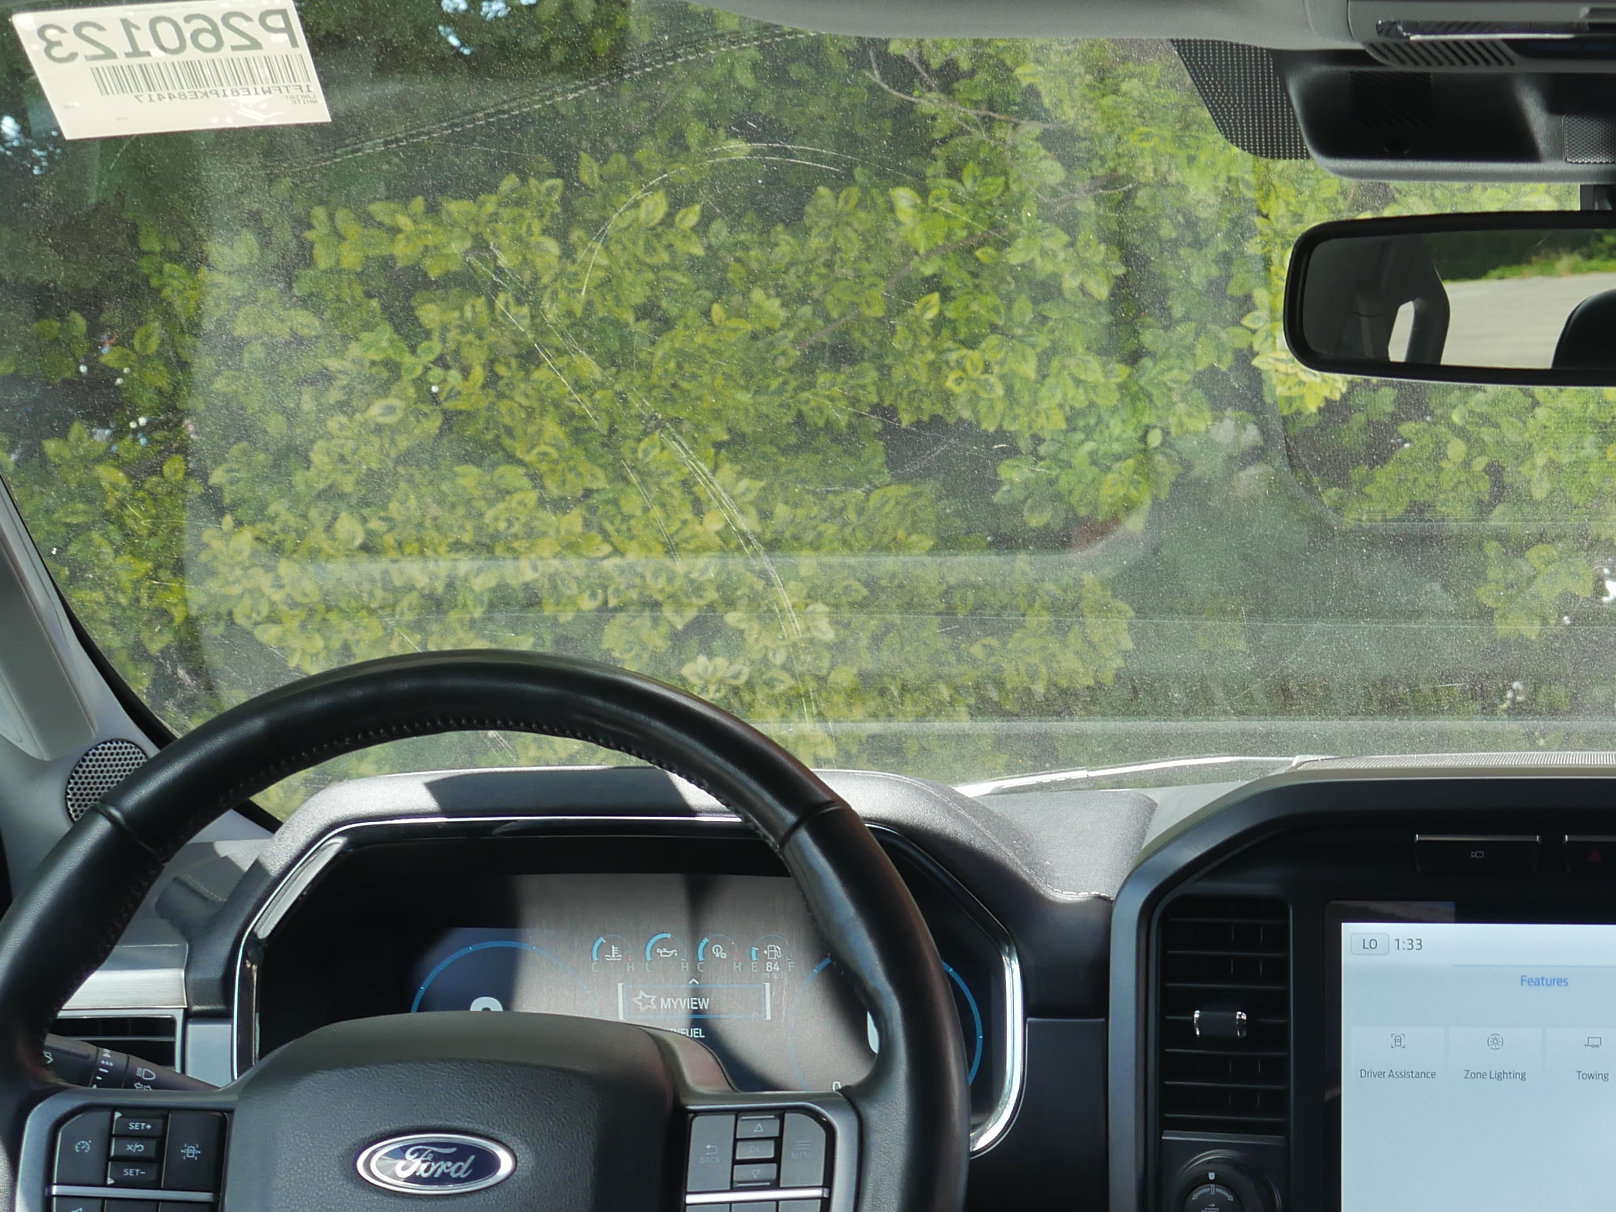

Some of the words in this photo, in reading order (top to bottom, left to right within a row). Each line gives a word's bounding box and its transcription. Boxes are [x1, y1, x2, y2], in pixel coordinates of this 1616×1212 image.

[1362, 938, 1378, 950] LO
[1395, 938, 1423, 951] 1:33
[765, 961, 780, 972] 84
[1520, 975, 1568, 988] Features
[660, 998, 710, 1010] MYVIEW
[1360, 1068, 1386, 1079] Driver
[1388, 1068, 1436, 1079] Assistance
[1464, 1069, 1487, 1080] Zone
[1489, 1069, 1527, 1082] Lighting
[1576, 1070, 1609, 1082] Towing
[395, 1145, 476, 1178] Ford
